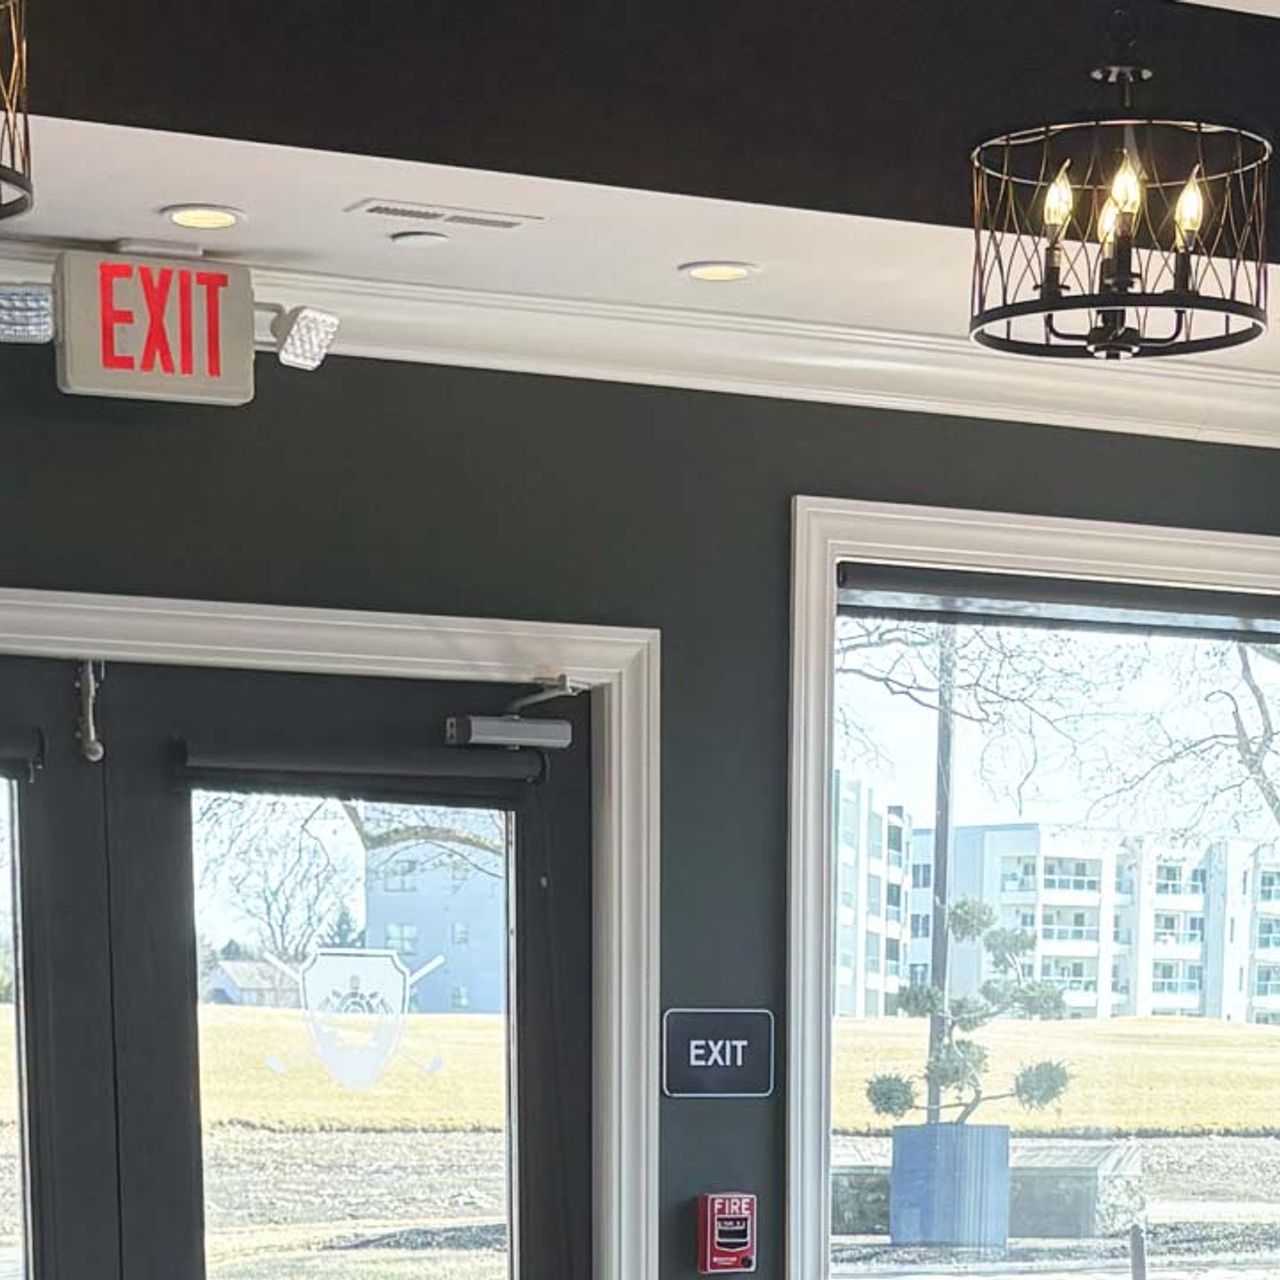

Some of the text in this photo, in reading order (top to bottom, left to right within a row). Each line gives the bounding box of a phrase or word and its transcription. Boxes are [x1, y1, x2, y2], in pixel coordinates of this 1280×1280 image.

[99, 262, 229, 378] EXIT
[689, 1039, 749, 1067] EXIT
[714, 1198, 752, 1215] FIRE
